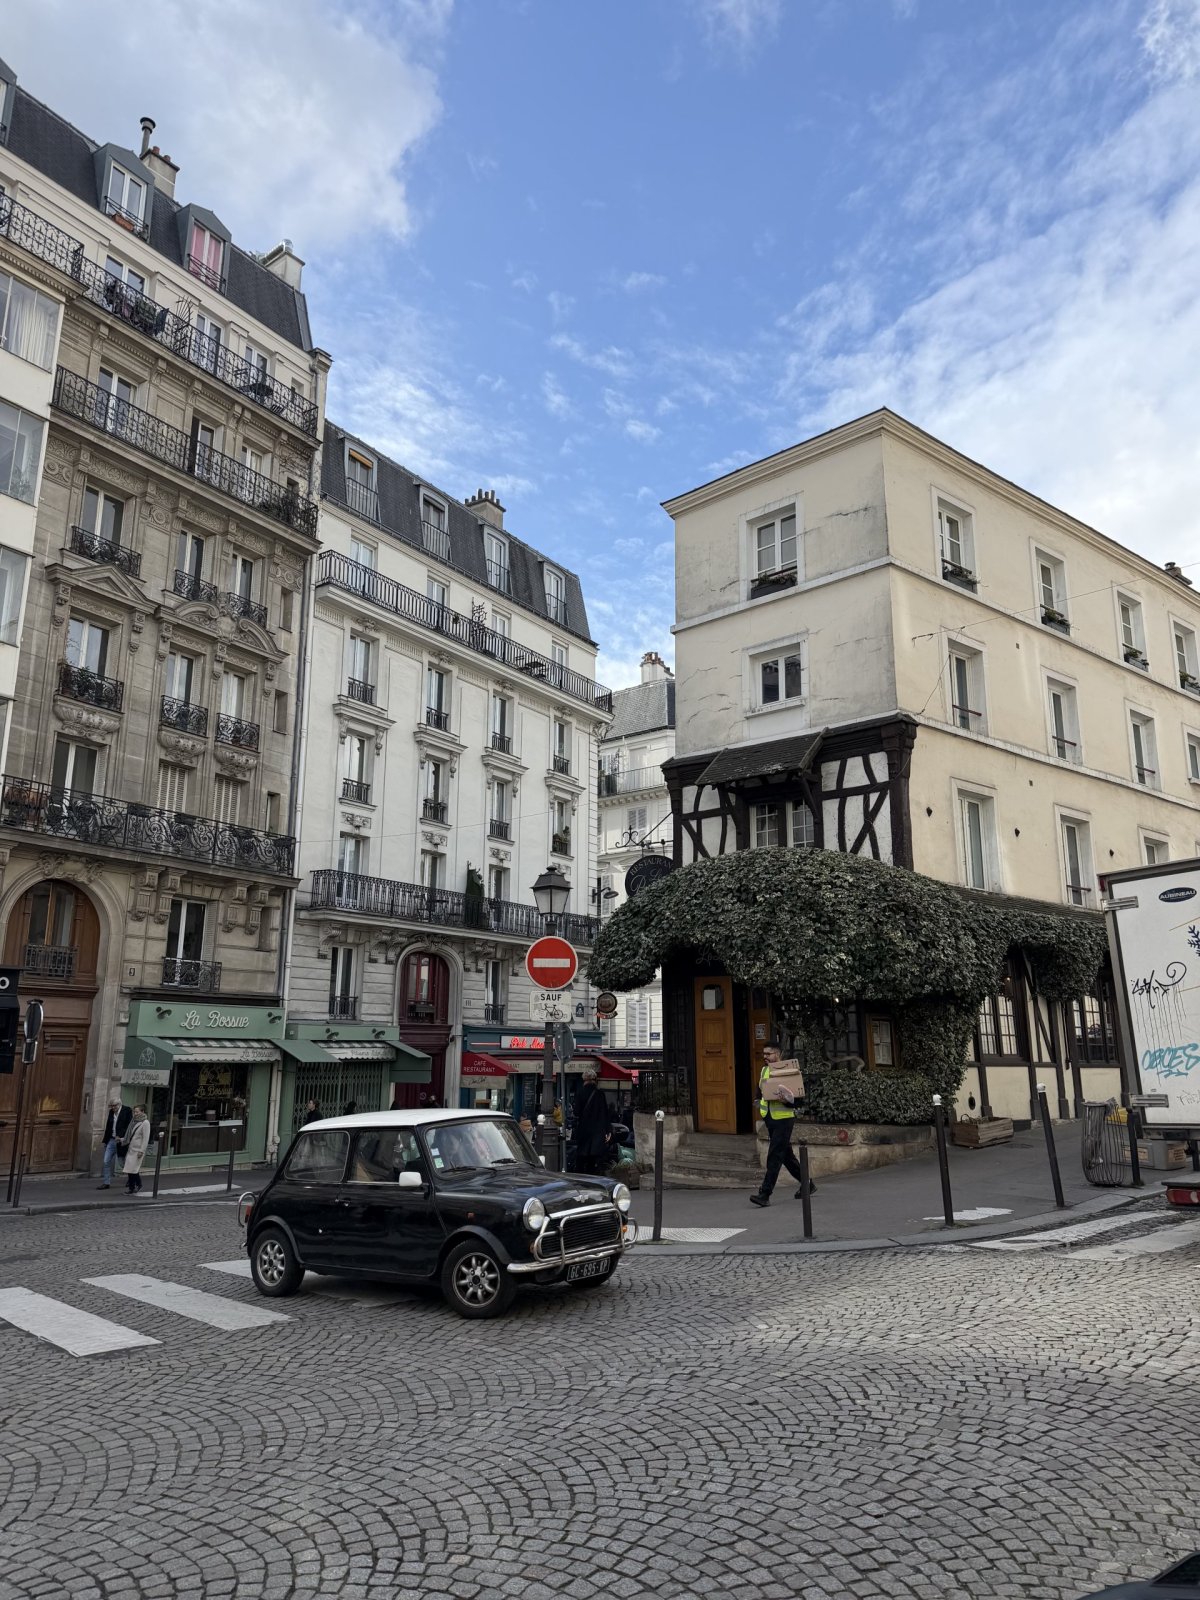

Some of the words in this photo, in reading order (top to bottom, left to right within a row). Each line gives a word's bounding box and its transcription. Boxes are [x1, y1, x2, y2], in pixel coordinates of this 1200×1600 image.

[1160, 890, 1195, 899] AUBINEAU
[540, 993, 562, 1001] SAUF
[180, 1010, 201, 1030] La
[206, 1010, 250, 1028] Bossue
